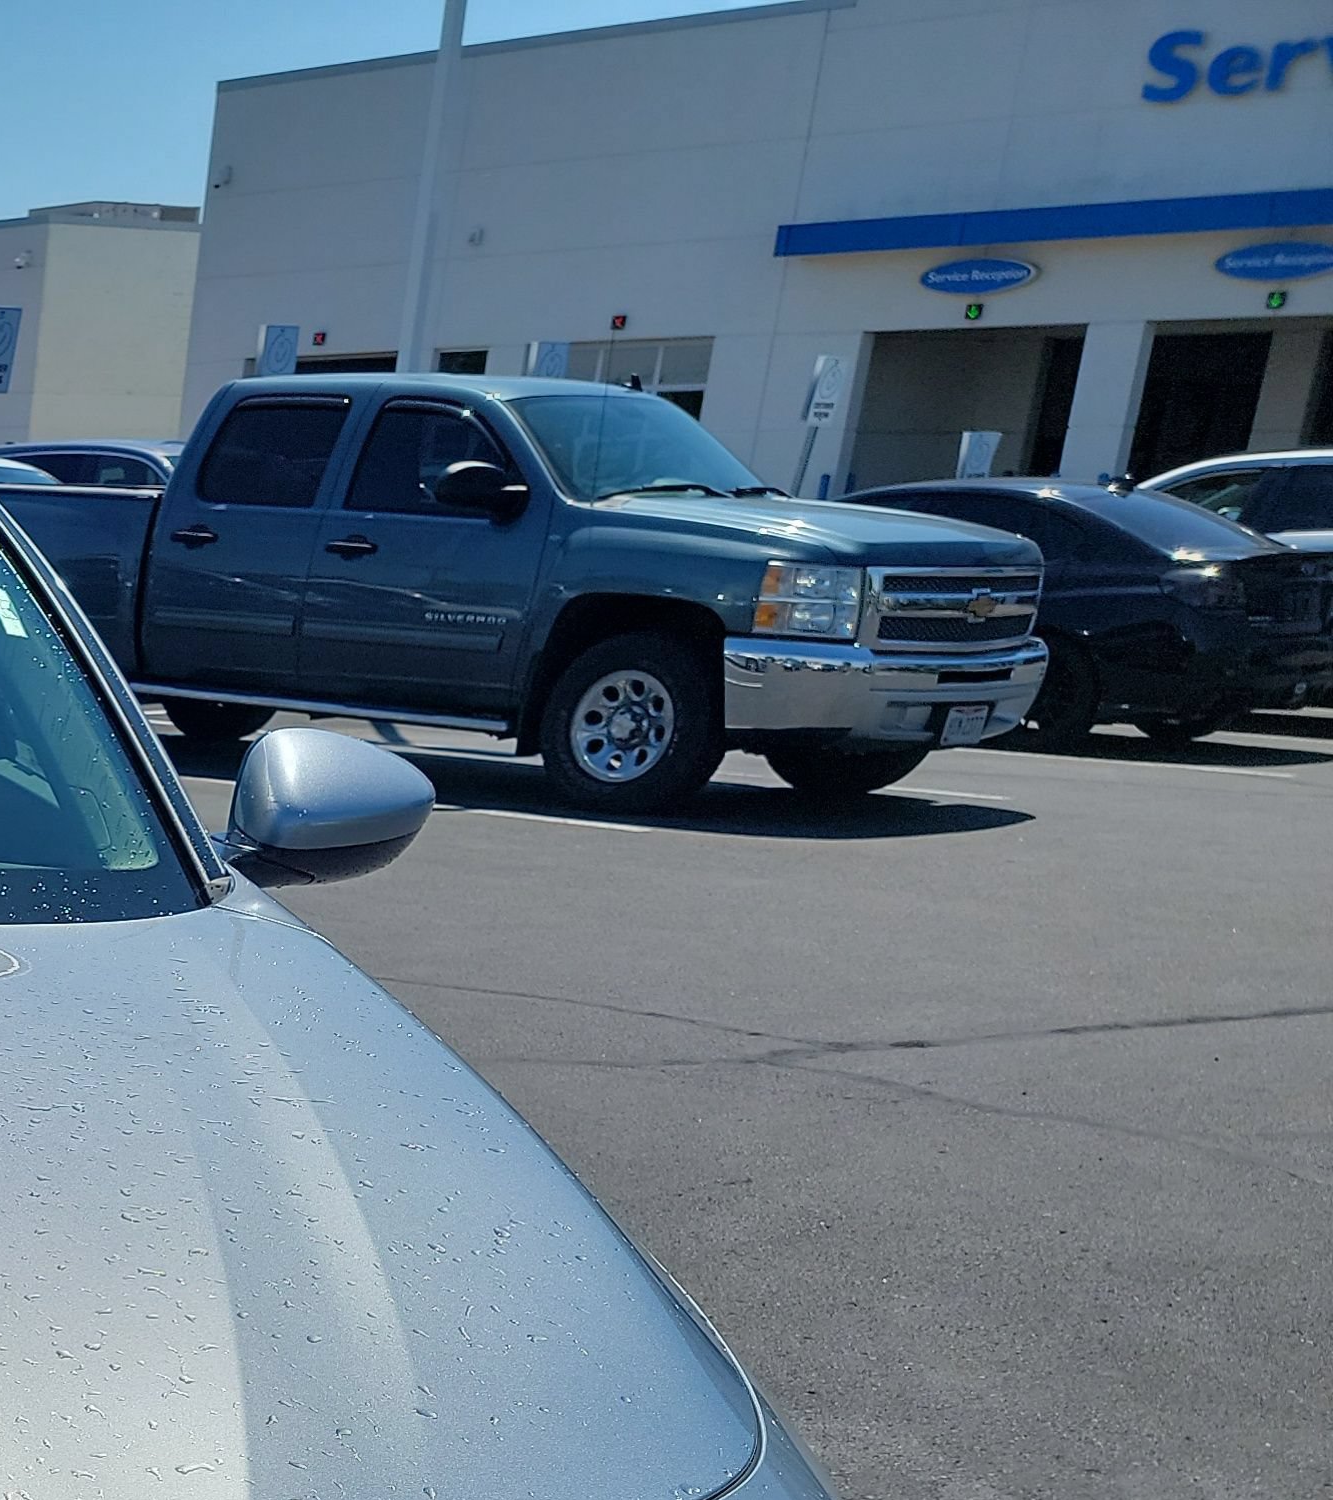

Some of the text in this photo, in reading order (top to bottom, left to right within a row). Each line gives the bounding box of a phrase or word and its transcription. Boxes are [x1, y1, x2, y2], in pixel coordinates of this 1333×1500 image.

[1141, 28, 1333, 103] Ser
[928, 269, 1028, 283] Service Reception
[424, 612, 507, 624] SILVERADO
